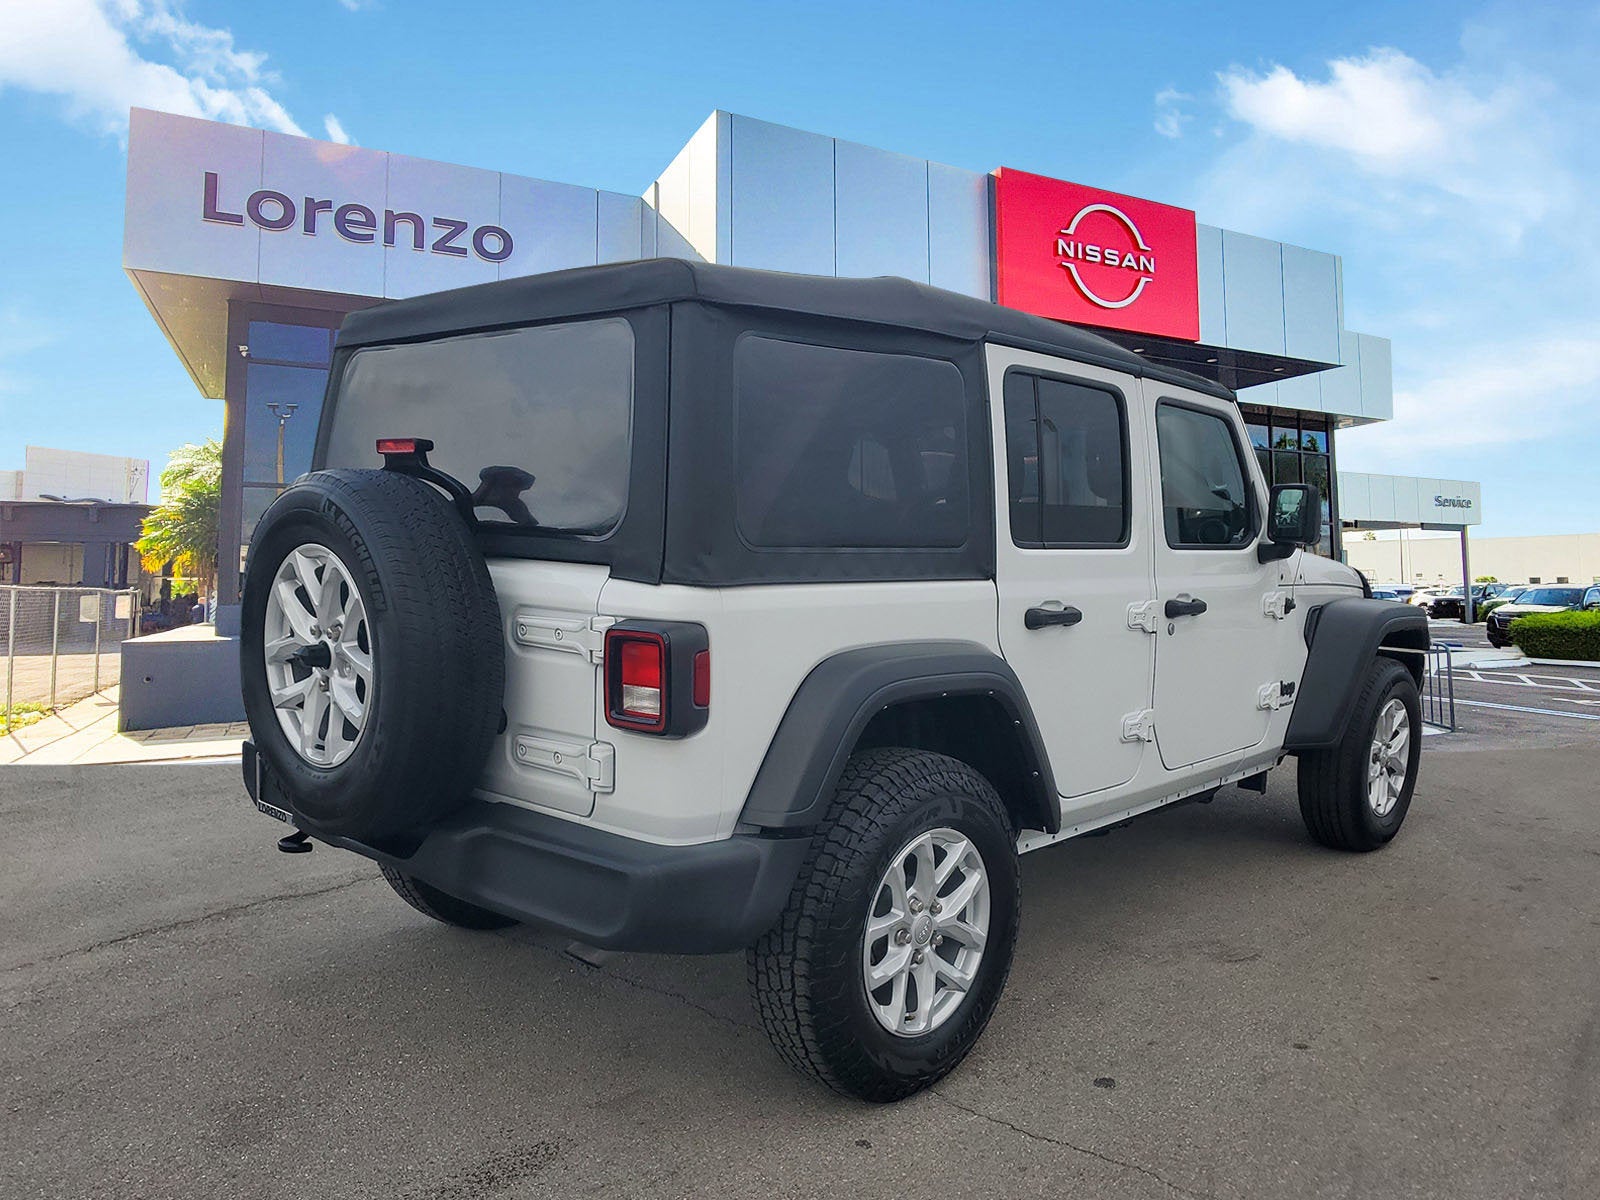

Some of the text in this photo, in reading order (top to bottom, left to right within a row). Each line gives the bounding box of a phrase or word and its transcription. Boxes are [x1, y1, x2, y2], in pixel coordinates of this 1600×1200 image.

[203, 172, 514, 262] Lorenzo
[1058, 238, 1155, 273] NISSAN
[1434, 495, 1472, 508] Service
[335, 510, 388, 612] MICHELIN
